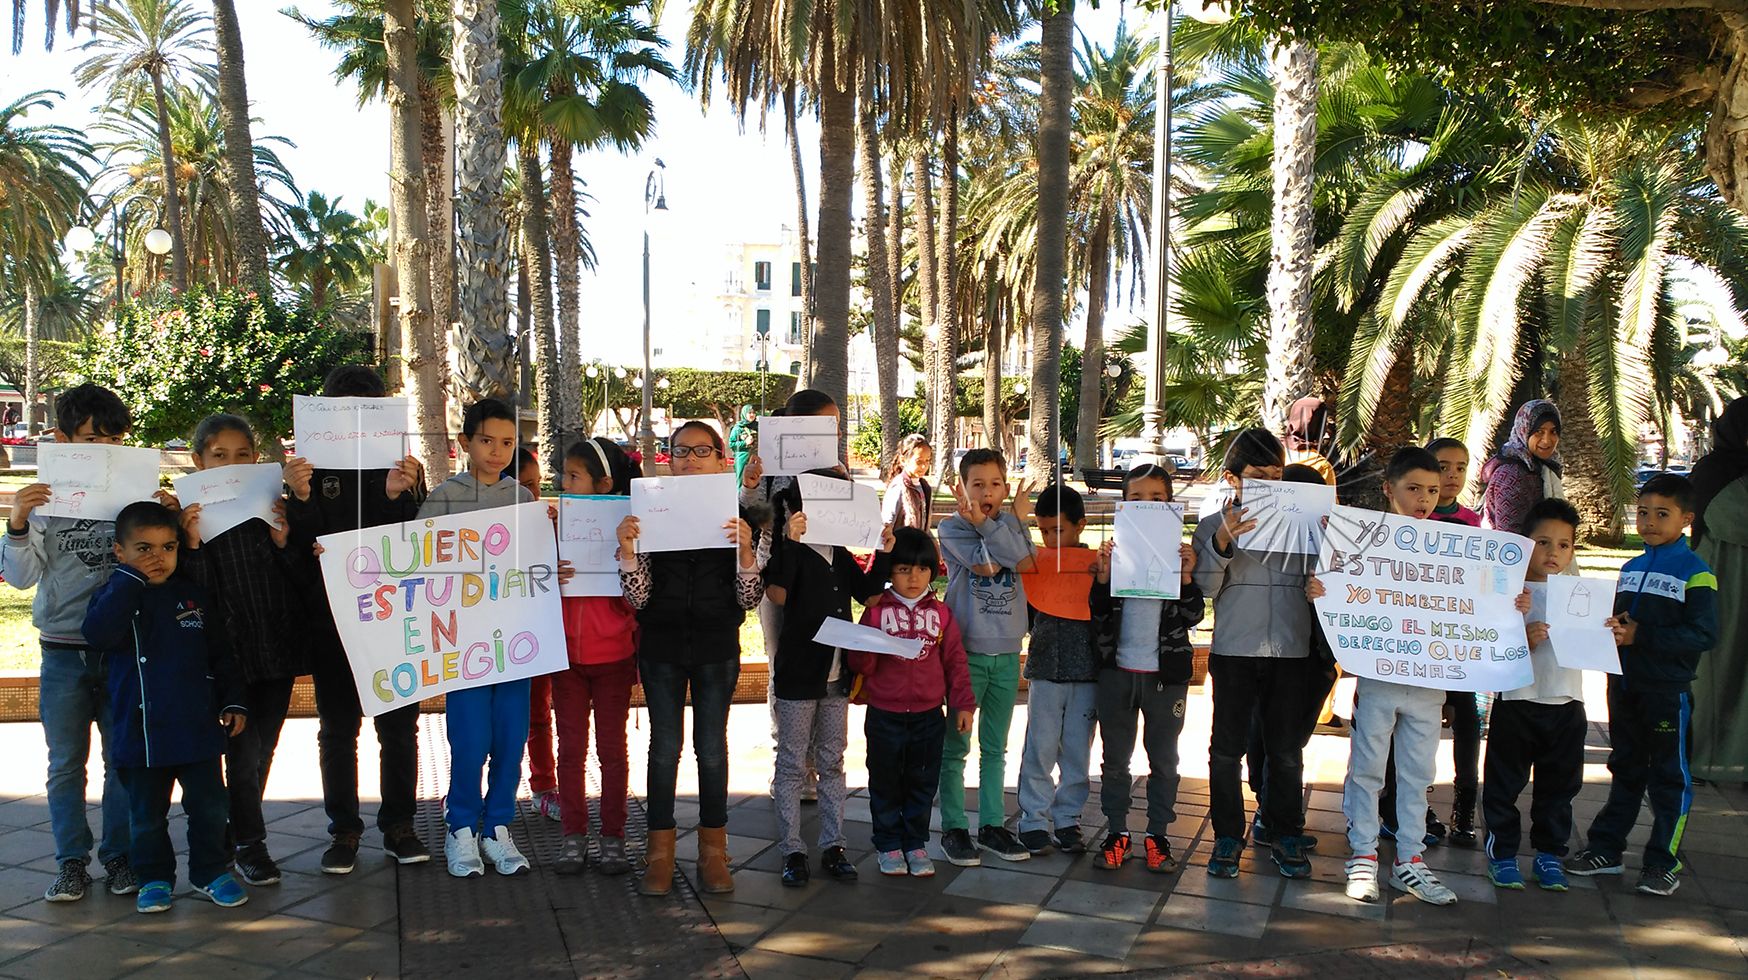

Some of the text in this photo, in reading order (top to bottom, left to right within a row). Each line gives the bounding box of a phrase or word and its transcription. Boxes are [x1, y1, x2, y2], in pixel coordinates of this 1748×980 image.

[1354, 519, 1523, 566] YO QUIERO
[1330, 549, 1465, 585] ESTUDIAR
[1346, 583, 1475, 615] YO TAMBIEN
[404, 609, 458, 656] EN
[1322, 611, 1499, 642] TENGO EL MISMO
[1337, 634, 1529, 662] DERECHO QUE LOS
[1375, 658, 1467, 680] DEMAS
